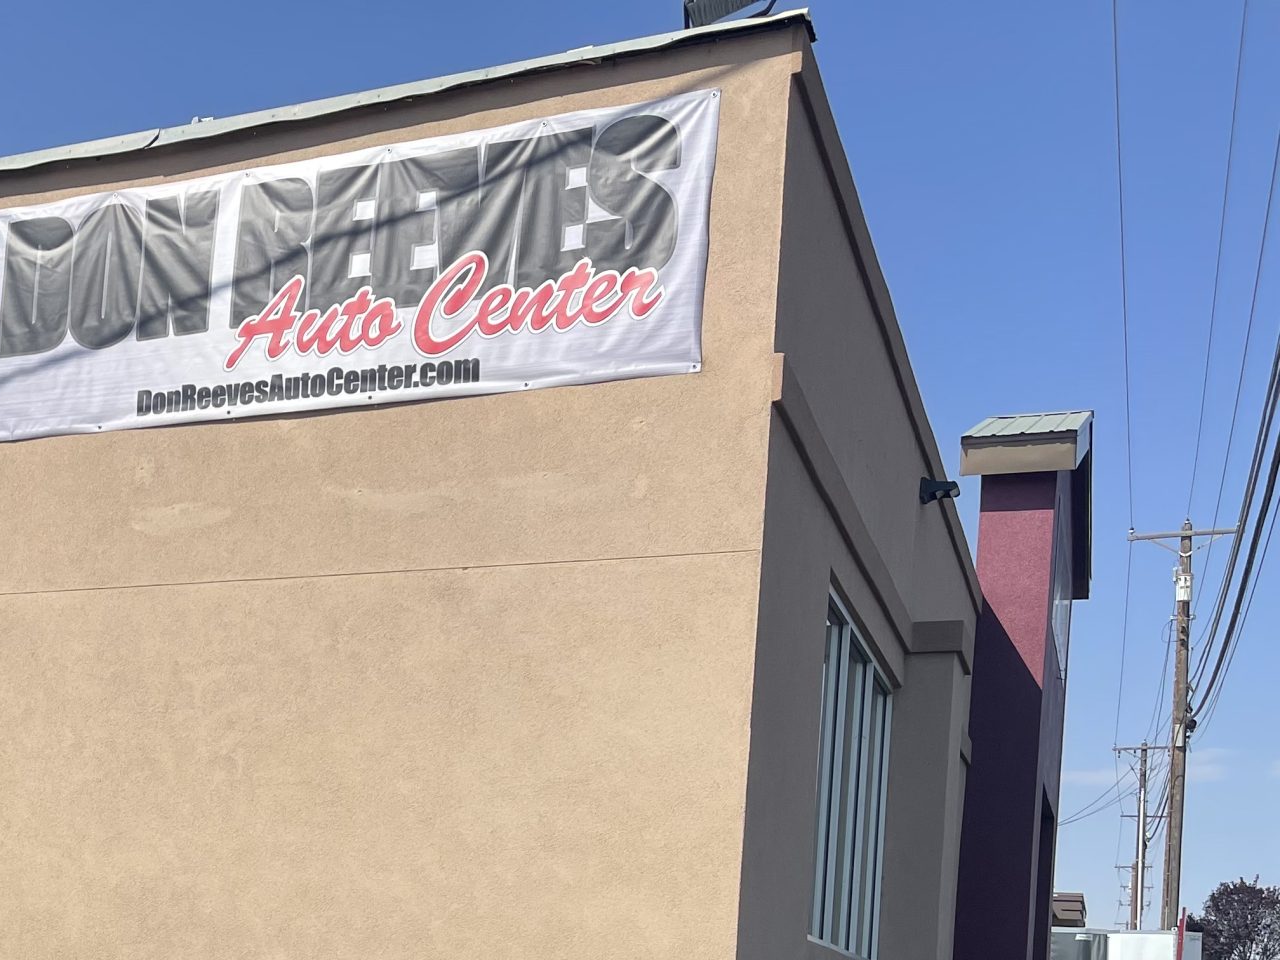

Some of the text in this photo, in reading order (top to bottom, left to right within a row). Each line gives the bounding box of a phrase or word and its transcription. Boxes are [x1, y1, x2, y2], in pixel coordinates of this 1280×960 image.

[232, 114, 682, 329] REEVES
[224, 251, 663, 370] Auto Center
[136, 356, 480, 416] DonReevesAutoCenter.com
